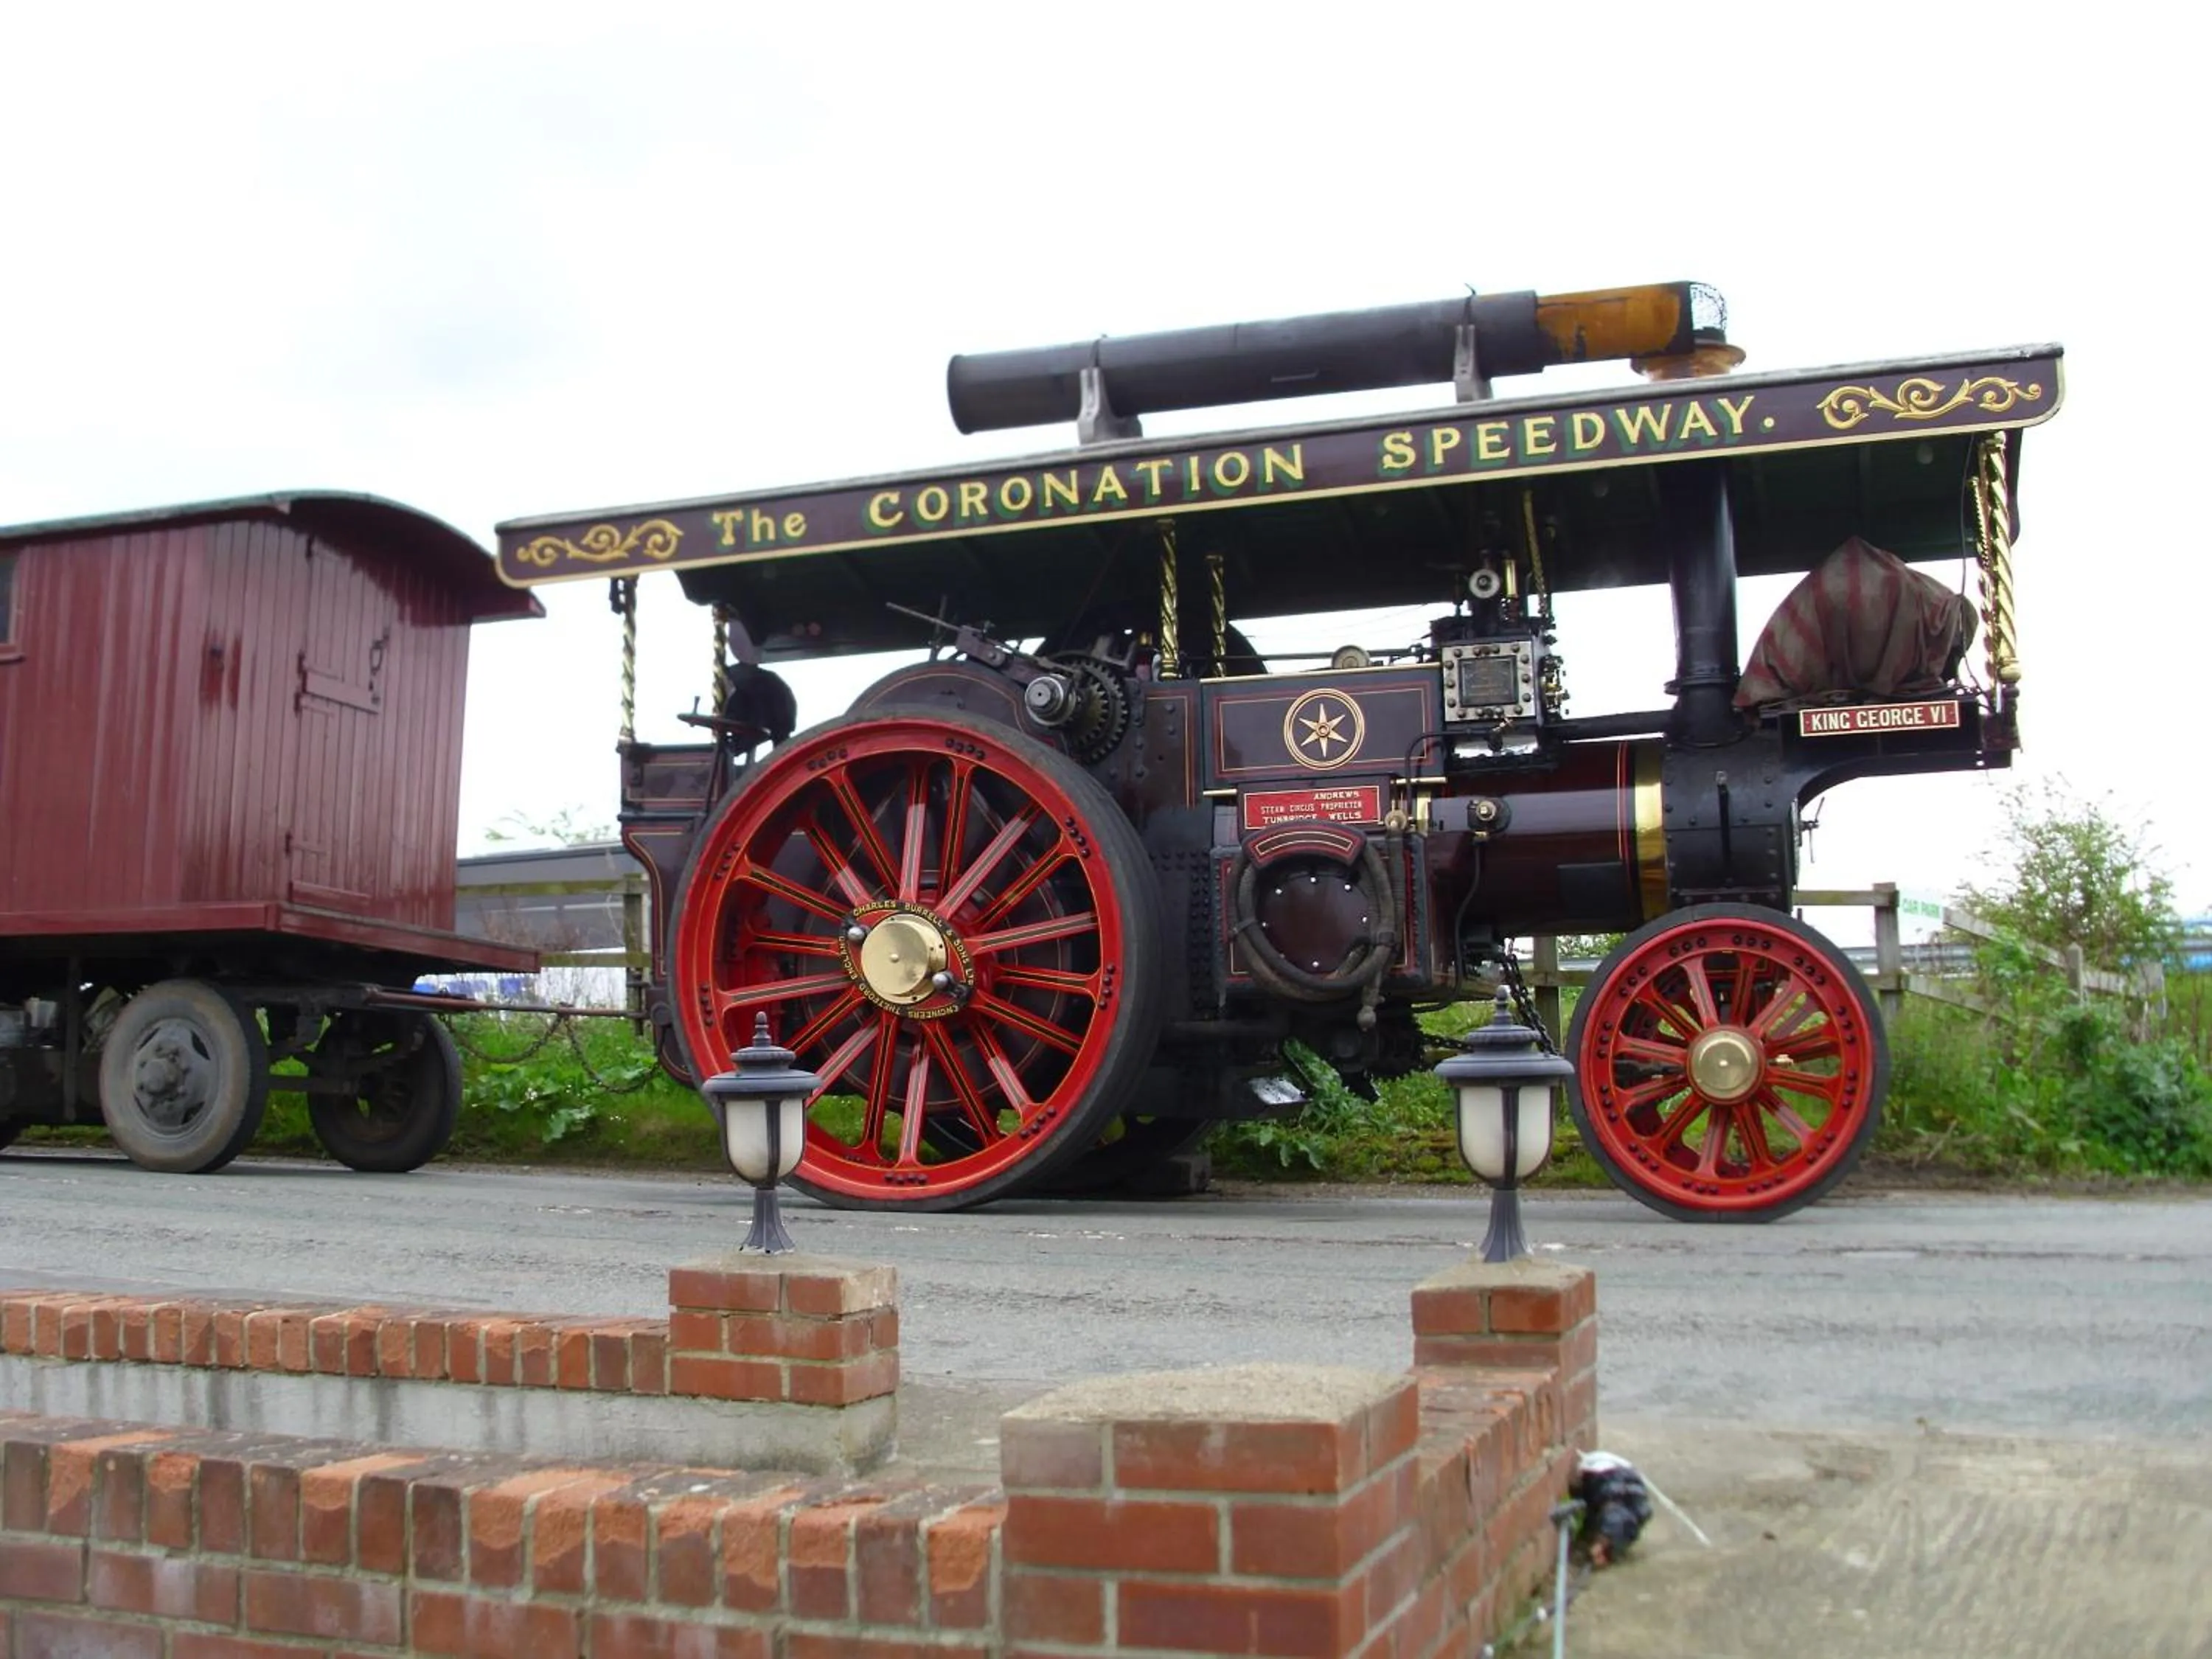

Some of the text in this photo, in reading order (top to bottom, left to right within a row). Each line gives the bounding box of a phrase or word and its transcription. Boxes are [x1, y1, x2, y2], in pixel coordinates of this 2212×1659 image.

[712, 395, 1775, 546] The CORONATION SPEEDWAY.
[1811, 706, 1947, 731] KING GEORGE VI
[1313, 790, 1360, 801] ANDREWS
[1260, 805, 1284, 815] STEAM
[1289, 803, 1315, 812] CIRCUS
[1328, 811, 1362, 821] WELLS
[853, 900, 897, 917] CHARLES
[905, 902, 943, 928] BURRELL
[953, 939, 970, 964] SONS
[838, 936, 901, 1015] THETFORD ENGLAND
[908, 1004, 959, 1019] ENGINEERS
